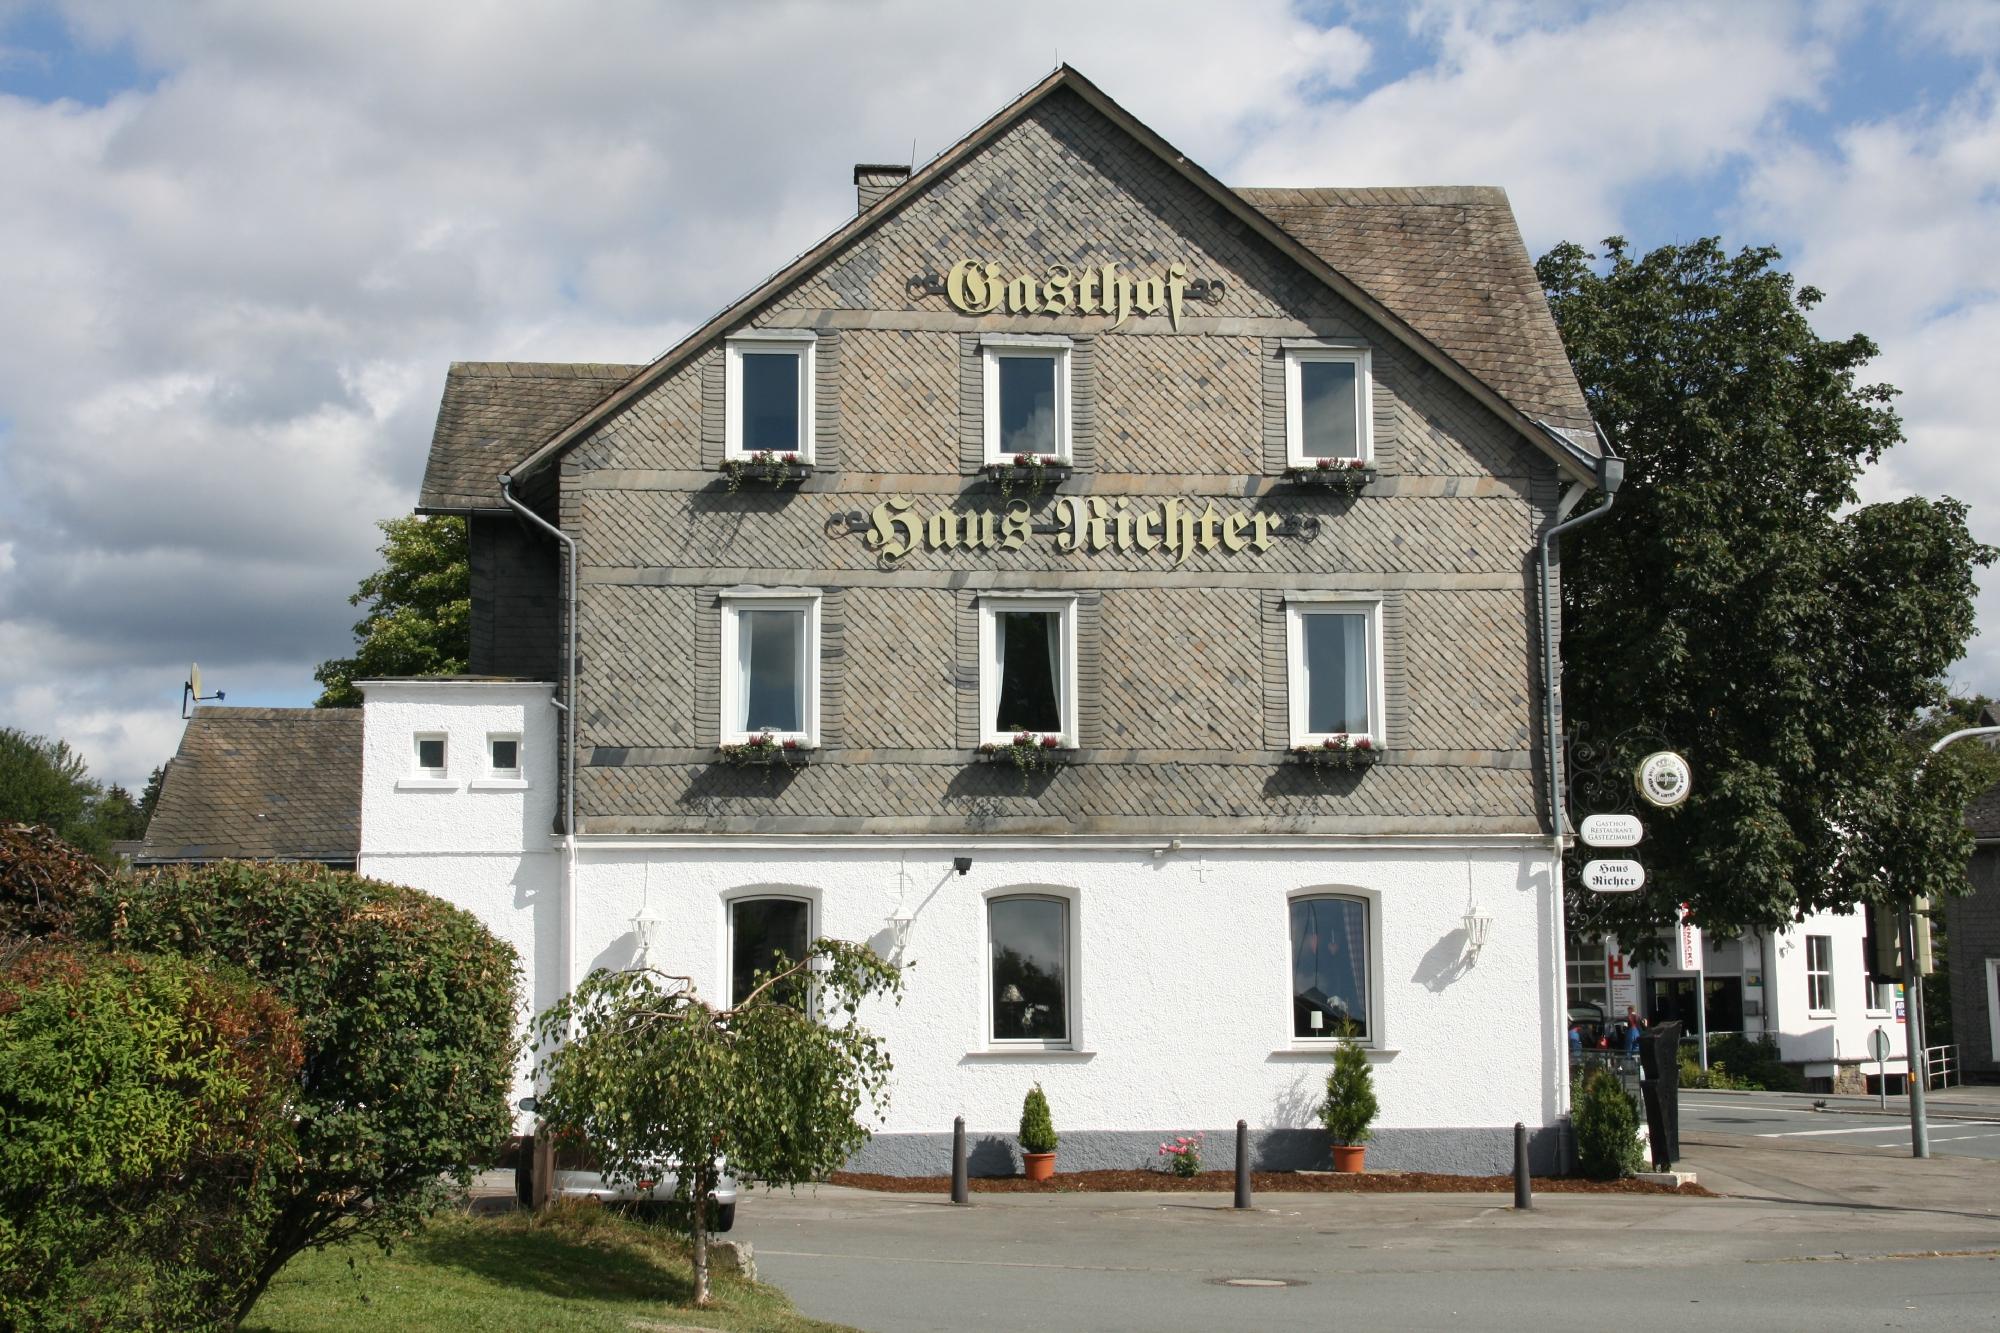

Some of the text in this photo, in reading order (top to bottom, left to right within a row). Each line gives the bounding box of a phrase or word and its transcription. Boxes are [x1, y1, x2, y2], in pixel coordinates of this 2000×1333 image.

[947, 259, 1187, 332] Gasthof
[866, 495, 1282, 565] Haus Richter
[1592, 875, 1636, 887] Richter
[1599, 863, 1629, 874] Haus
